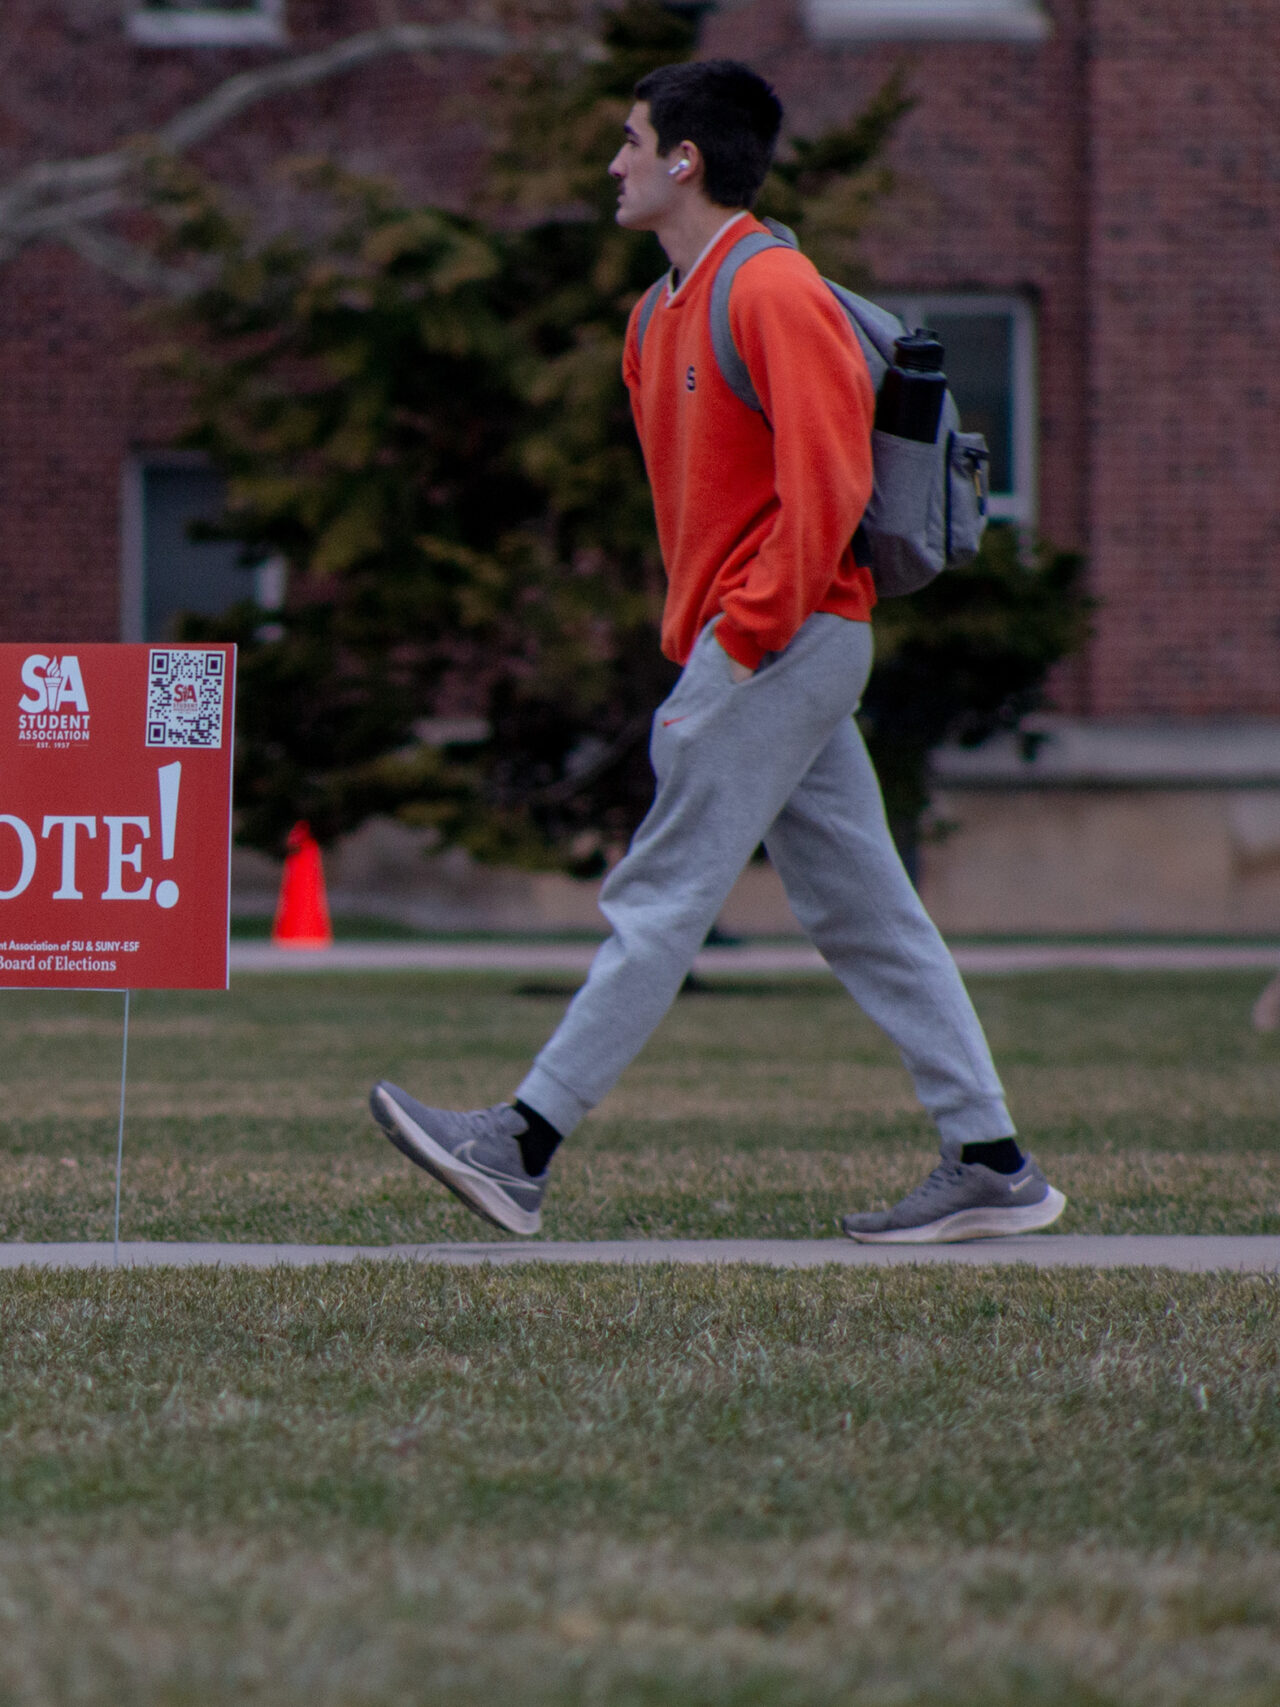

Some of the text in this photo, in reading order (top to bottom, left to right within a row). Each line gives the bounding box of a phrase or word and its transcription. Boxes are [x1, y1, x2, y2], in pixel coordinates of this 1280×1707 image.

[686, 364, 696, 391] S
[18, 714, 91, 729] STUDENT
[18, 730, 90, 741] ASSOCIATION
[8, 939, 59, 951] Association
[60, 940, 70, 951] of
[71, 941, 84, 951] SU
[85, 941, 93, 951] &
[95, 941, 140, 952] SUNY-ESF
[38, 955, 54, 971] of
[55, 956, 117, 972] Elections
